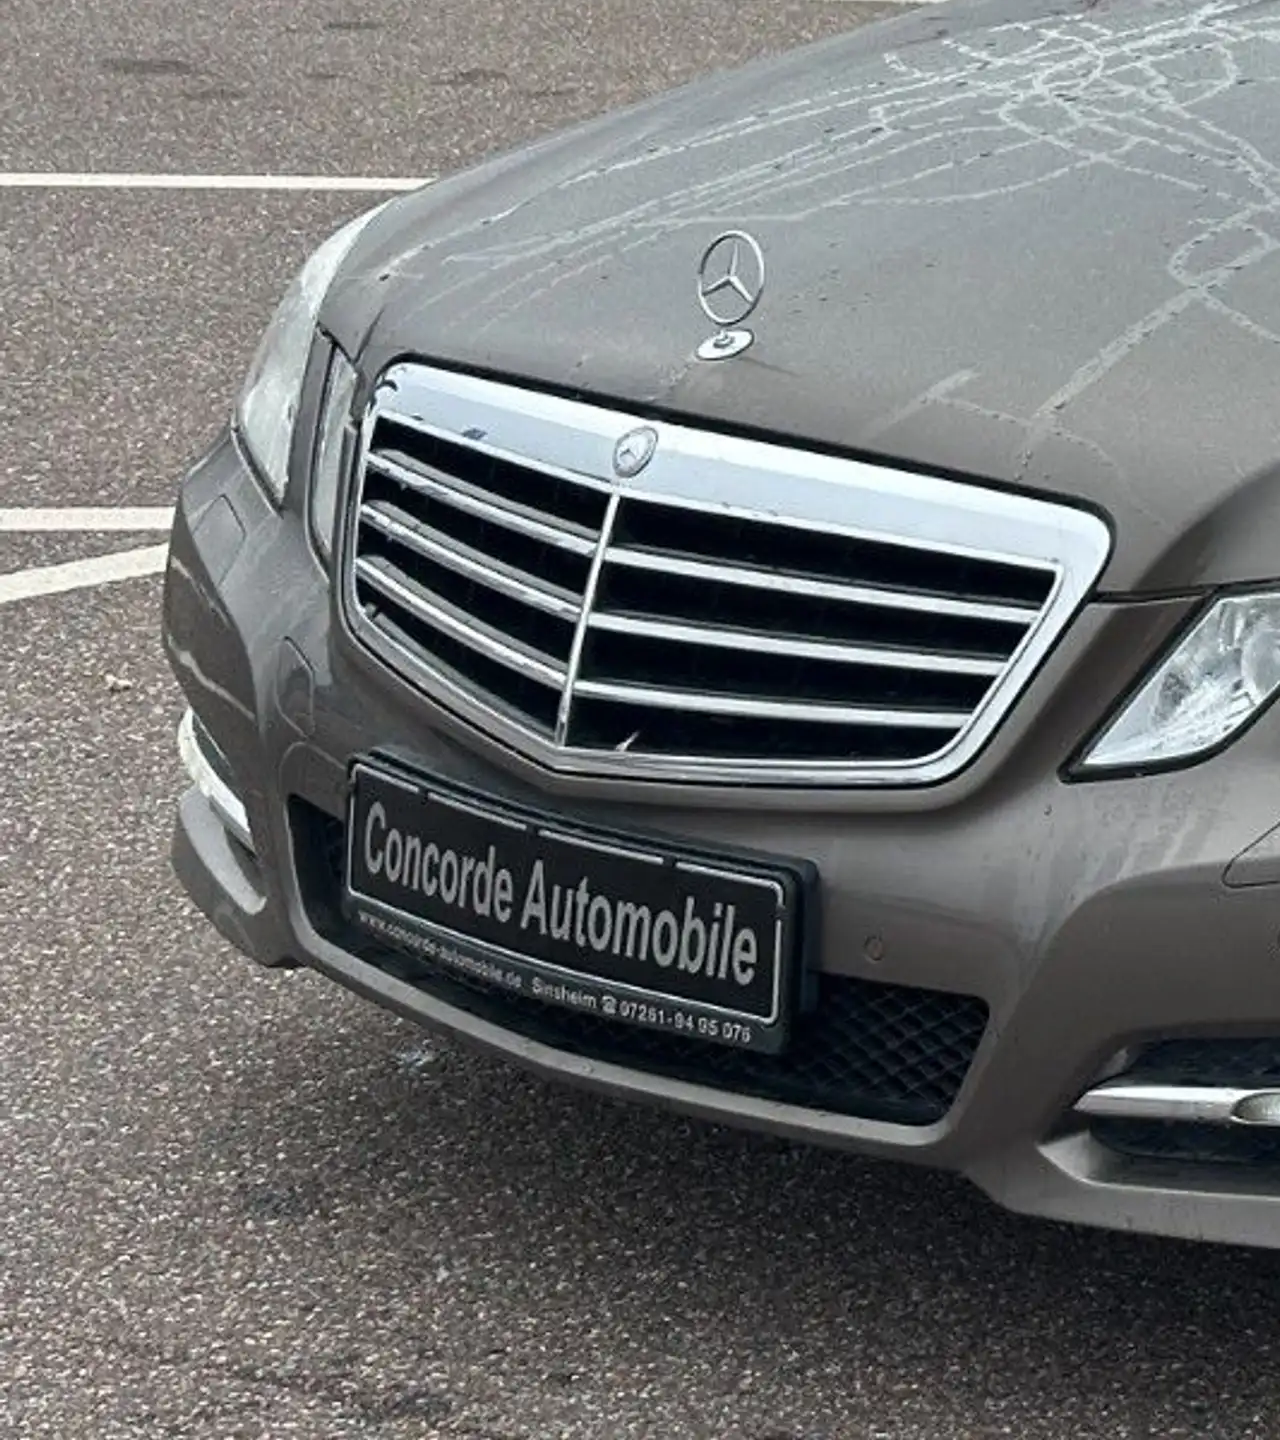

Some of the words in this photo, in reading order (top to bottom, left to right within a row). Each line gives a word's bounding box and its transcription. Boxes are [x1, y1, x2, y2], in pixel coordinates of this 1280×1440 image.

[364, 800, 514, 924] Concorde
[520, 859, 758, 986] Automobile
[531, 976, 598, 1009] Sinsheim
[722, 1021, 751, 1043] 076
